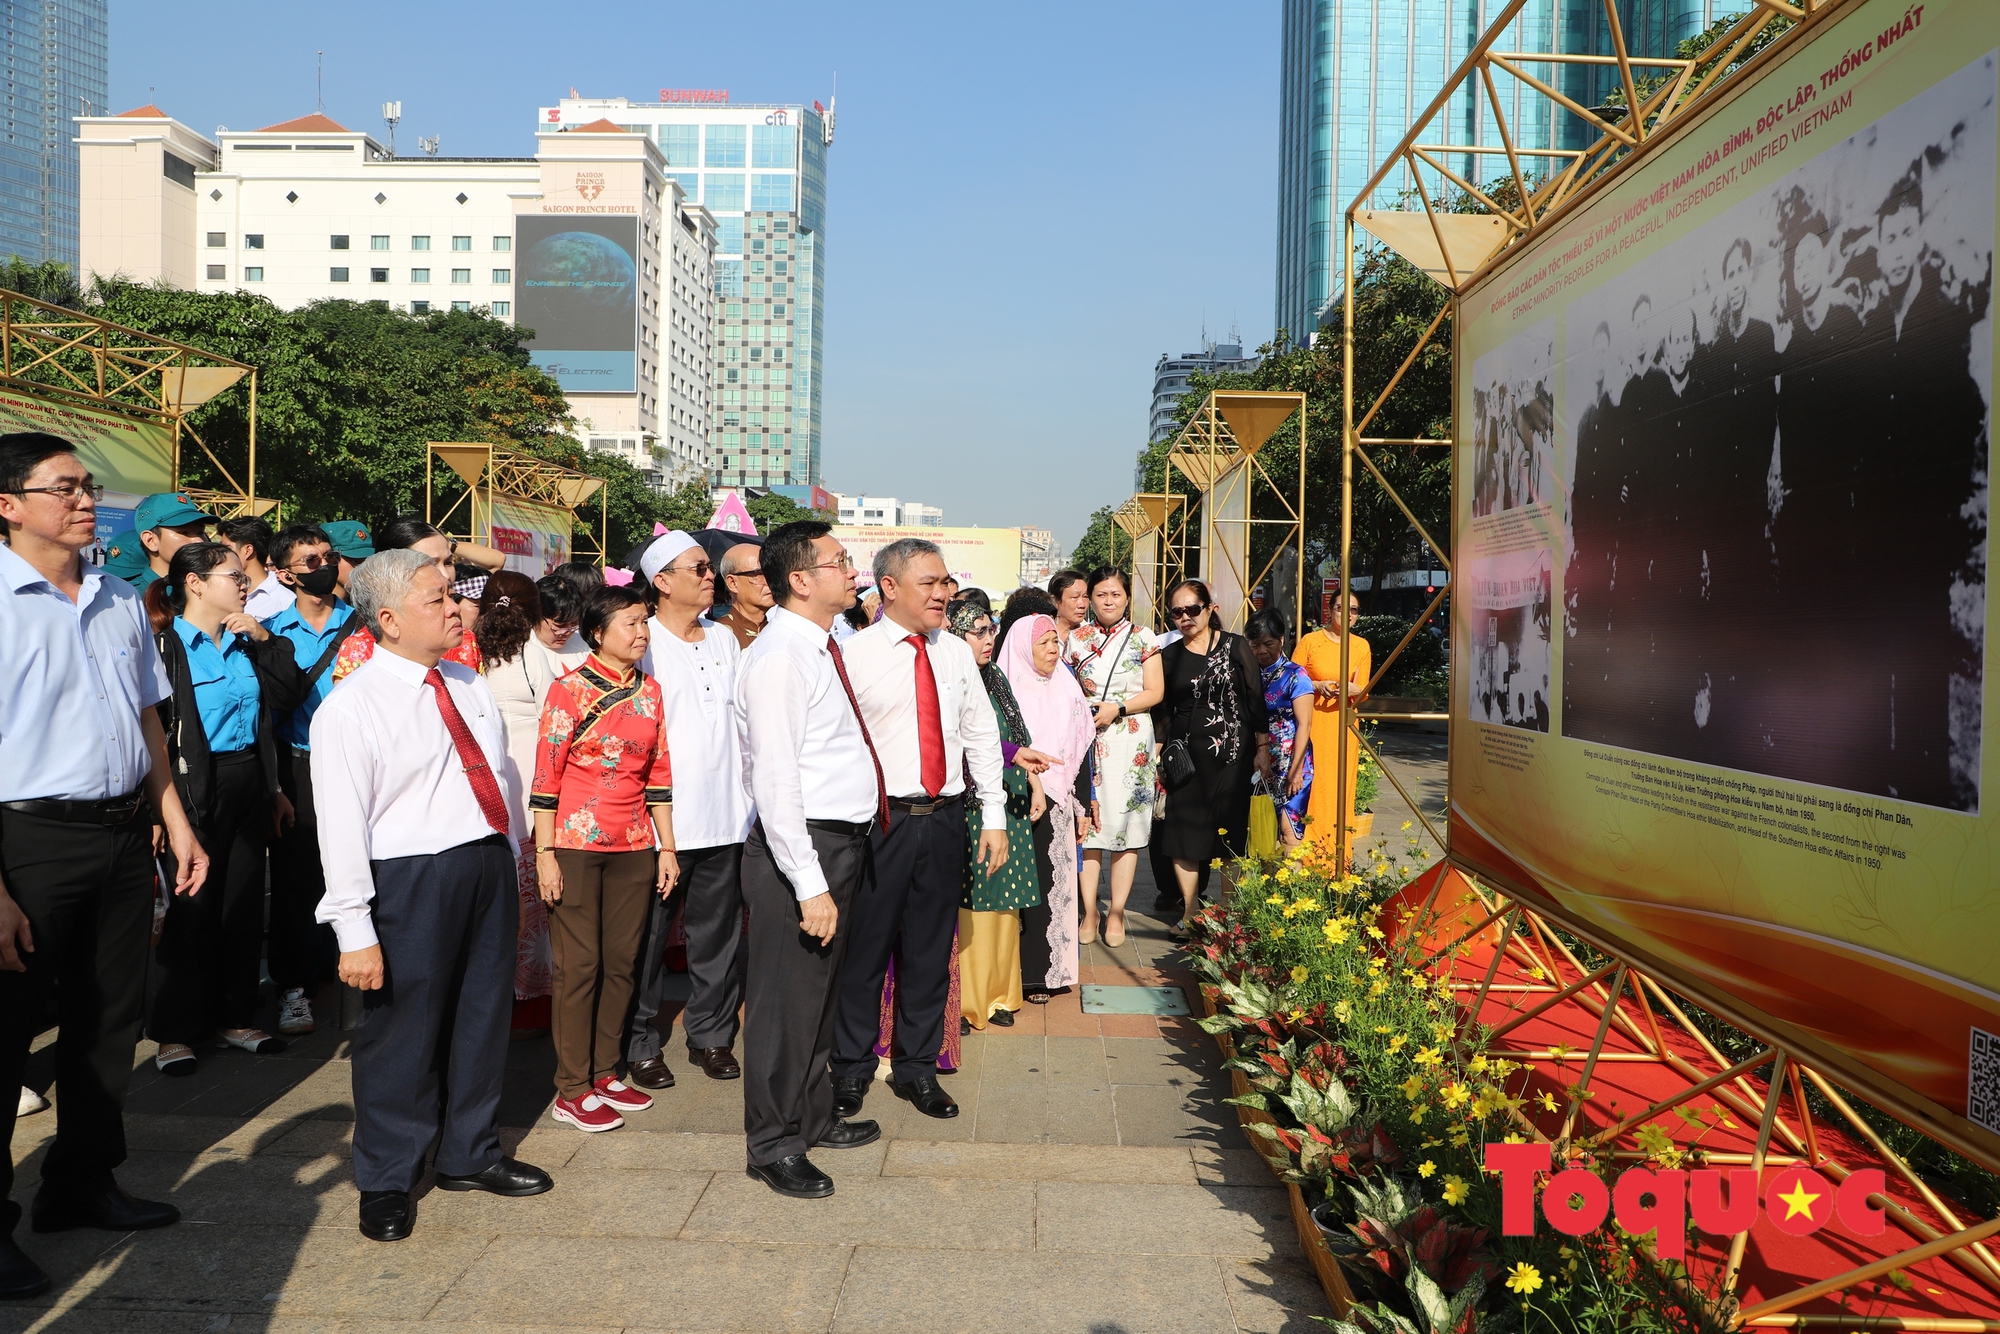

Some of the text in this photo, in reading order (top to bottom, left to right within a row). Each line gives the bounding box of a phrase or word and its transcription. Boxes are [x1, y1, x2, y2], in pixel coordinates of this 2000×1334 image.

[660, 89, 728, 102] SUNWAH
[765, 109, 787, 125] citi
[1491, 4, 1924, 314] ĐỒNG BÀO CÁC DÂN TỘC THIỂU SỐ VÌ MỘT NƯỚC VIỆT NAM HÒA BÌNH, ĐỘC LẬP, THỐNG NHẤT
[1512, 90, 1853, 320] ETHNIC MINORITY PEOPLES FOR A PEACEFUL, INDEPENDENT, UNIFIED VIETNAM
[7, 399, 23, 407] MINH
[25, 403, 43, 411] ĐOÀN
[58, 409, 74, 418] CÙNG
[75, 413, 95, 423] THÀNH
[123, 424, 138, 432] TRIỂN
[46, 417, 72, 427] DEVELOP
[1586, 772, 1600, 782] Comrade
[1606, 777, 1615, 786] Duan
[1622, 780, 1631, 790] other
[1632, 784, 1650, 794] comrades
[1650, 788, 1664, 800] leading
[1672, 794, 1684, 803] South
[1698, 800, 1720, 812] resistance
[1731, 810, 1748, 820] against
[1759, 815, 1777, 827] French
[1778, 820, 1810, 836] colonialists,
[1811, 828, 1820, 838] the
[1822, 831, 1845, 844] second
[1846, 836, 1860, 848] from
[1862, 840, 1872, 851] the
[1875, 843, 1890, 856] right
[1892, 849, 1906, 860] was
[1645, 774, 1653, 783] Ban
[1654, 777, 1662, 785] Hoa
[1697, 786, 1713, 799] Trưởng
[1714, 791, 1730, 803] phòng
[1731, 794, 1741, 804] Hoa
[1742, 797, 1753, 806] kiều
[1754, 801, 1761, 810] vụ
[1762, 802, 1774, 812] Nam
[1776, 804, 1785, 816] bộ,
[1786, 807, 1798, 817] năm
[1800, 810, 1816, 821] 1950.
[1666, 767, 1675, 776] Nam
[1683, 771, 1695, 782] trong
[1696, 773, 1710, 785] kháng
[1711, 777, 1724, 786] chiến
[1725, 779, 1741, 791] chống
[1758, 787, 1774, 797] người
[1775, 789, 1785, 799] thứ
[1786, 791, 1795, 800] hai
[1796, 793, 1803, 802] từ
[1804, 796, 1817, 806] phải
[1818, 800, 1834, 811] sang
[1836, 801, 1842, 811] là
[1843, 802, 1860, 817] đồng
[1862, 807, 1873, 817] chí
[1875, 809, 1893, 822] Phan
[1896, 813, 1913, 828] Dân,
[1595, 786, 1610, 796] Comrade
[1611, 789, 1620, 798] Phan
[1620, 792, 1628, 801] Dan,
[1629, 795, 1639, 804] Head
[1651, 800, 1660, 811] Party
[1661, 803, 1686, 817] Committee's
[1687, 810, 1695, 819] Hoa
[1696, 813, 1707, 822] ethic
[1708, 816, 1736, 831] Mobilization,
[1737, 824, 1746, 833] and
[1747, 826, 1761, 837] Head
[1762, 830, 1768, 839] of
[1769, 832, 1777, 842] the
[1778, 834, 1803, 848] Southern
[1805, 841, 1817, 852] Hoa
[1818, 846, 1833, 856] ethic
[1834, 849, 1854, 862] Affairs
[1856, 856, 1862, 864] in
[1864, 857, 1882, 870] 1950.
